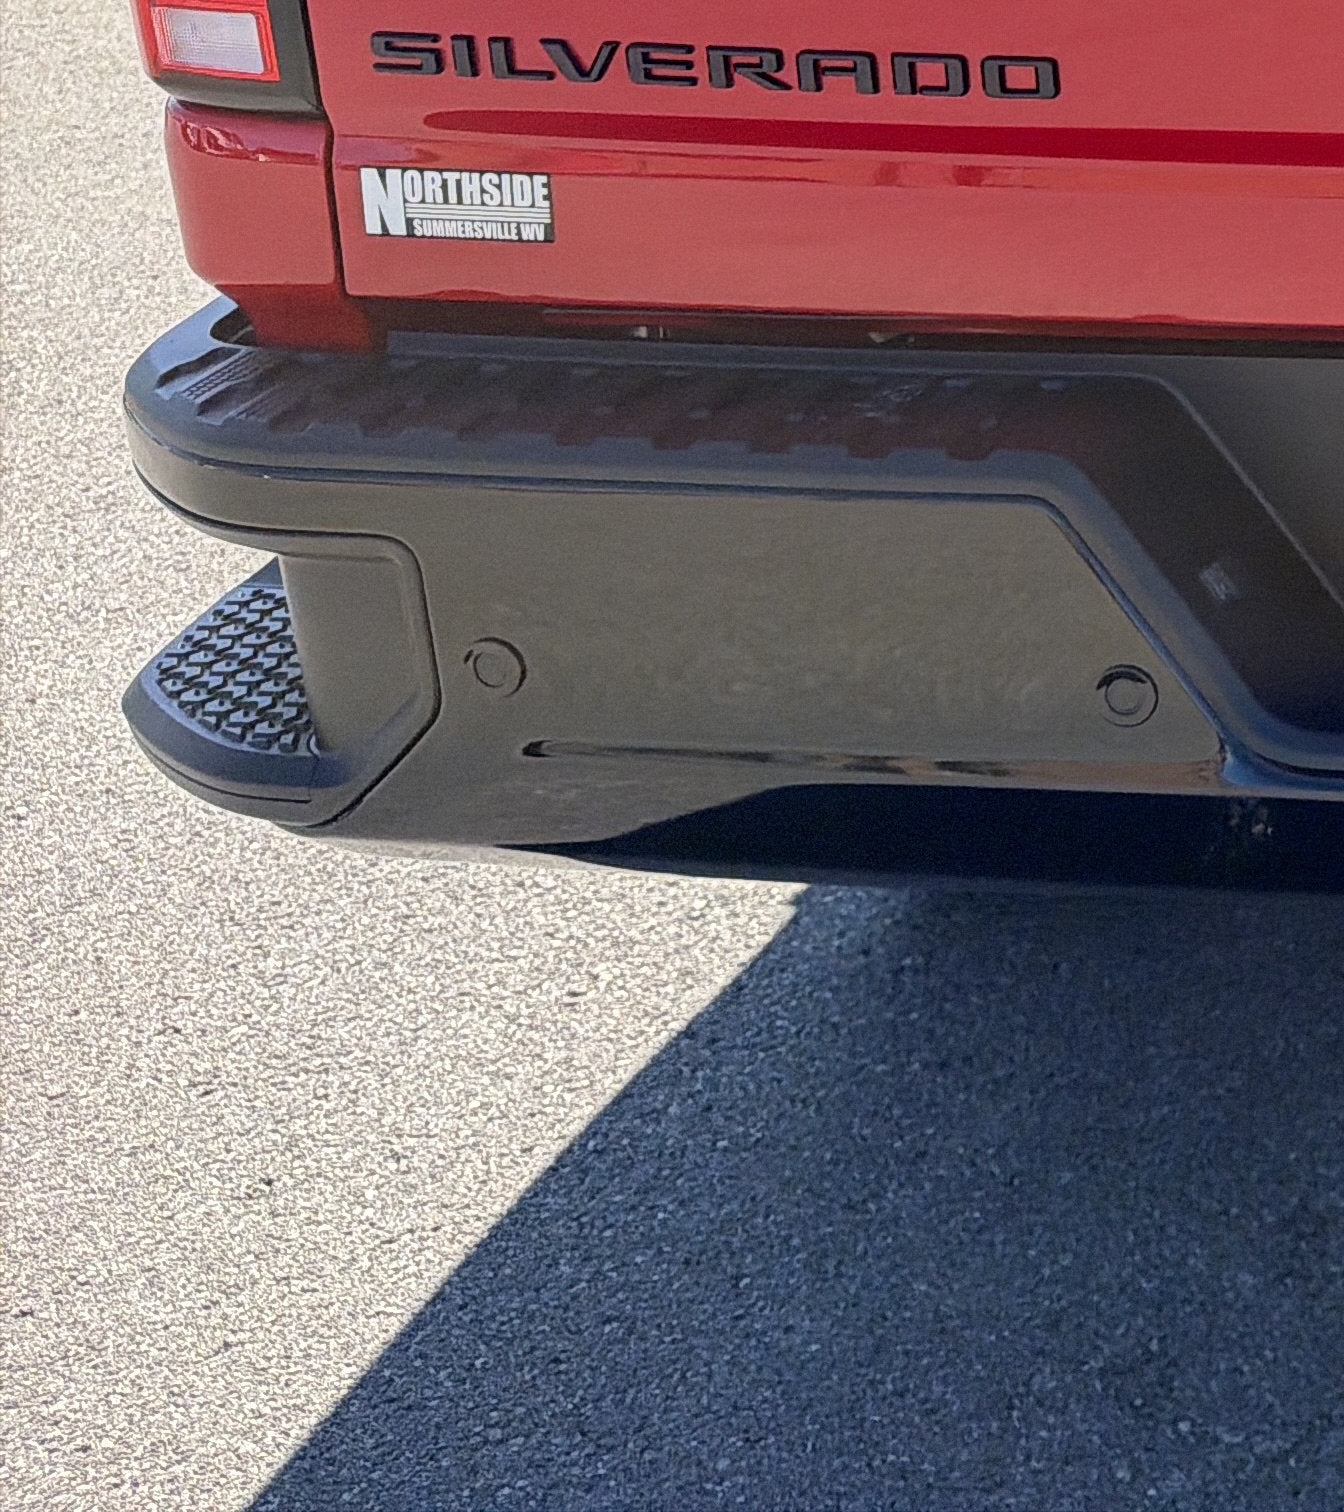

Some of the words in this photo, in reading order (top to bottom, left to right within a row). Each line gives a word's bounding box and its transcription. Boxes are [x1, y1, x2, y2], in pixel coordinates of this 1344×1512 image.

[370, 31, 1060, 100] SILVERADO
[360, 167, 552, 237] NORTHSIDE
[412, 219, 519, 241] SUMMERSVILLE
[519, 223, 546, 242] WV
